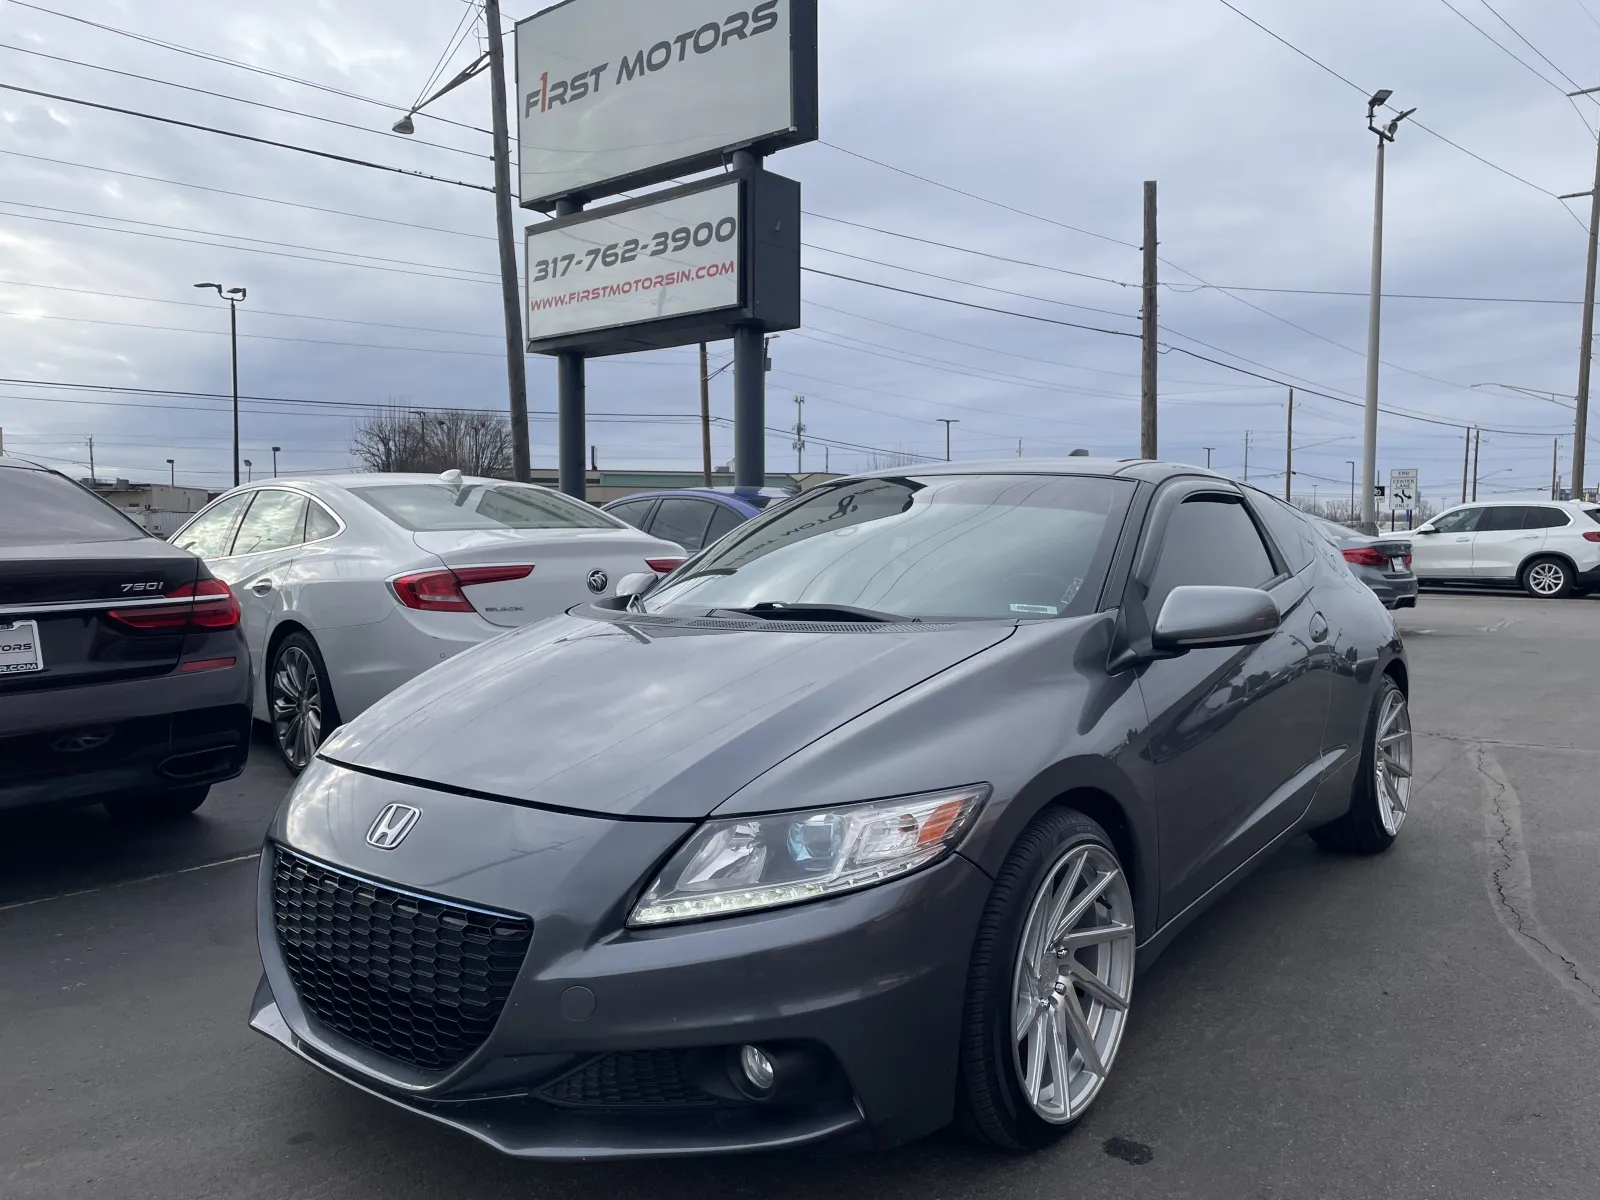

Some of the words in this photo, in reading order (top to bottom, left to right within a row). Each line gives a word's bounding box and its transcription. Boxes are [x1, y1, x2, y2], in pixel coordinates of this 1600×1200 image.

[615, 0, 779, 86] MOTORS
[533, 216, 737, 283] 317-762-3900
[530, 260, 735, 312] WWW.FIRSTMOTORSIN.COM
